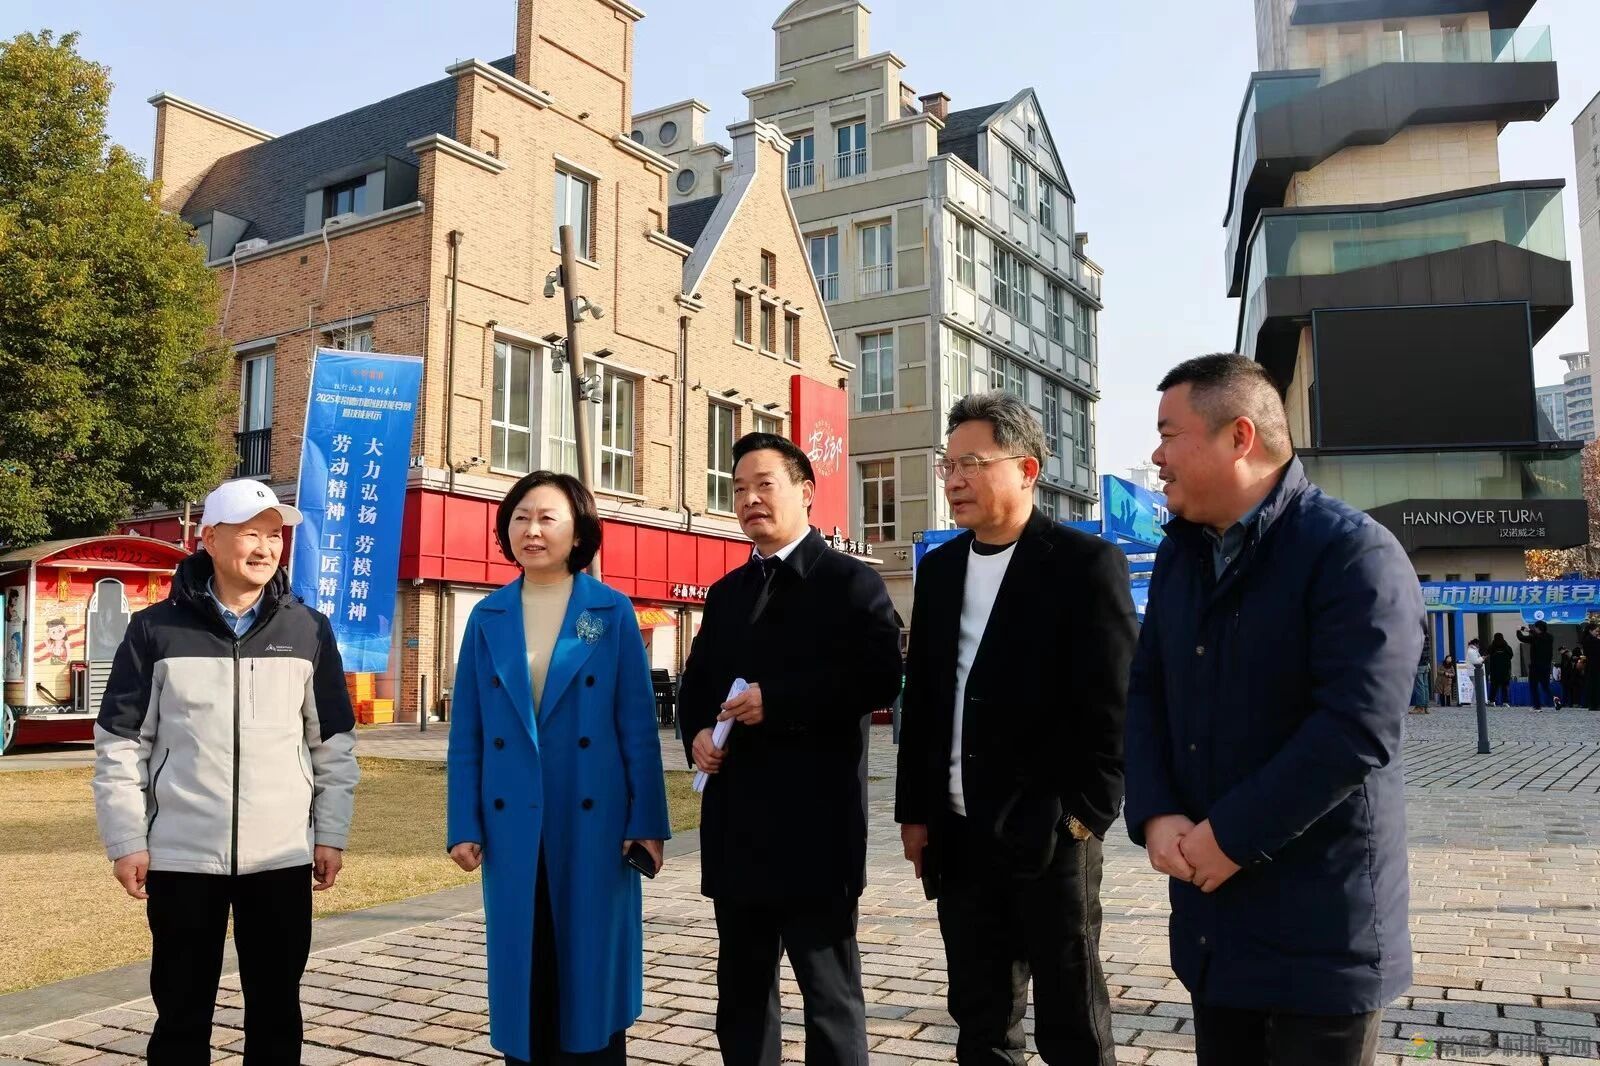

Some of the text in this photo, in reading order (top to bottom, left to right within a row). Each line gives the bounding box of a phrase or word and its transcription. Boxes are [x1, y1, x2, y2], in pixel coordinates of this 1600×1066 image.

[317, 433, 352, 619] 劳动精神 工匠精神
[1403, 509, 1544, 525] HANNOVER TURM
[347, 437, 384, 622] 大力弘扬 劳模精神
[1499, 527, 1546, 538] 汉诺威之塔
[1423, 585, 1600, 605] 德市职业技能竞
